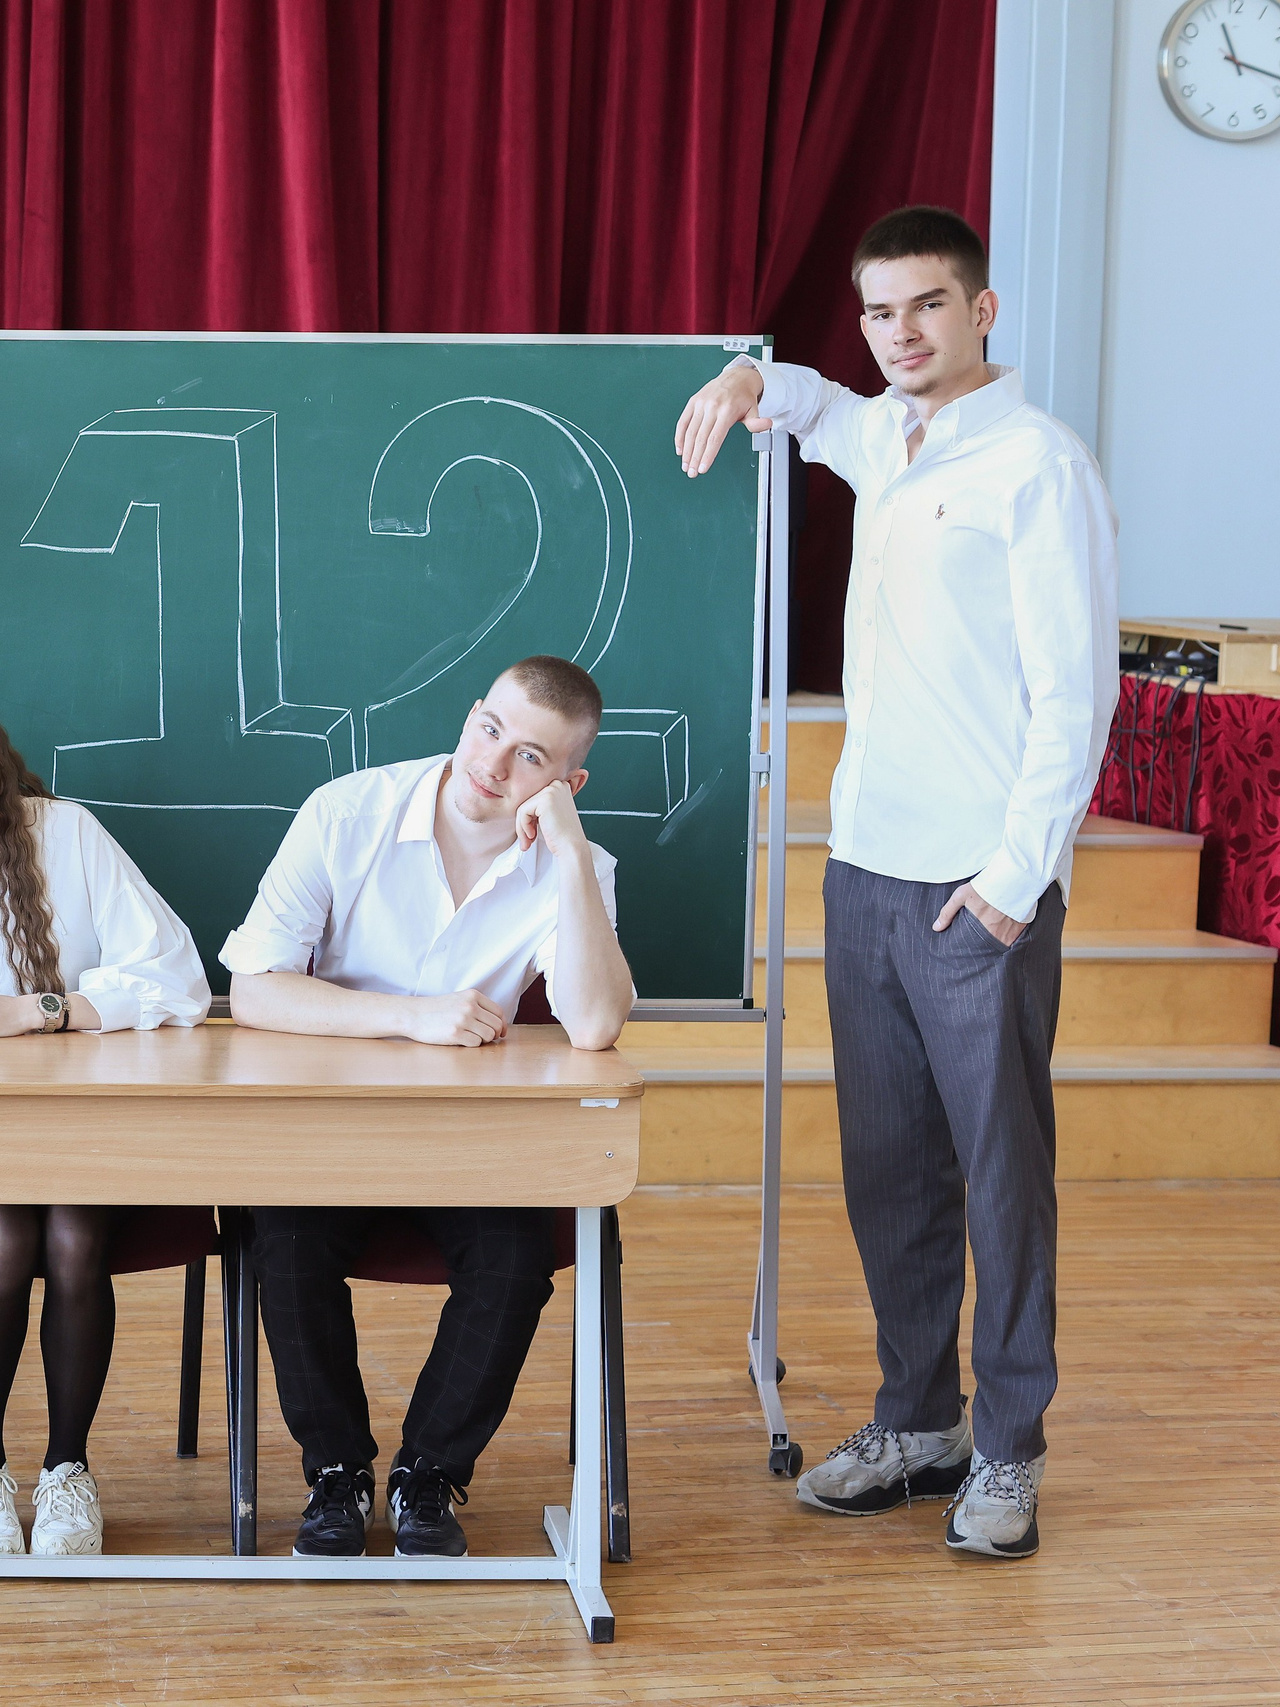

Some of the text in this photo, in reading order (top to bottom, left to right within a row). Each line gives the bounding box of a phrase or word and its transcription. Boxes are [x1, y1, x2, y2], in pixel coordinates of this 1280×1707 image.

[1228, 0, 1244, 13] 12
[1258, 5, 1268, 20] 1
[1179, 22, 1199, 45] 10
[1182, 83, 1197, 97] 8
[1201, 102, 1215, 117] 7
[1253, 103, 1267, 120] 5
[1228, 111, 1239, 127] 6
[21, 396, 690, 820] 12
[69, 1463, 83, 1477] NIK
